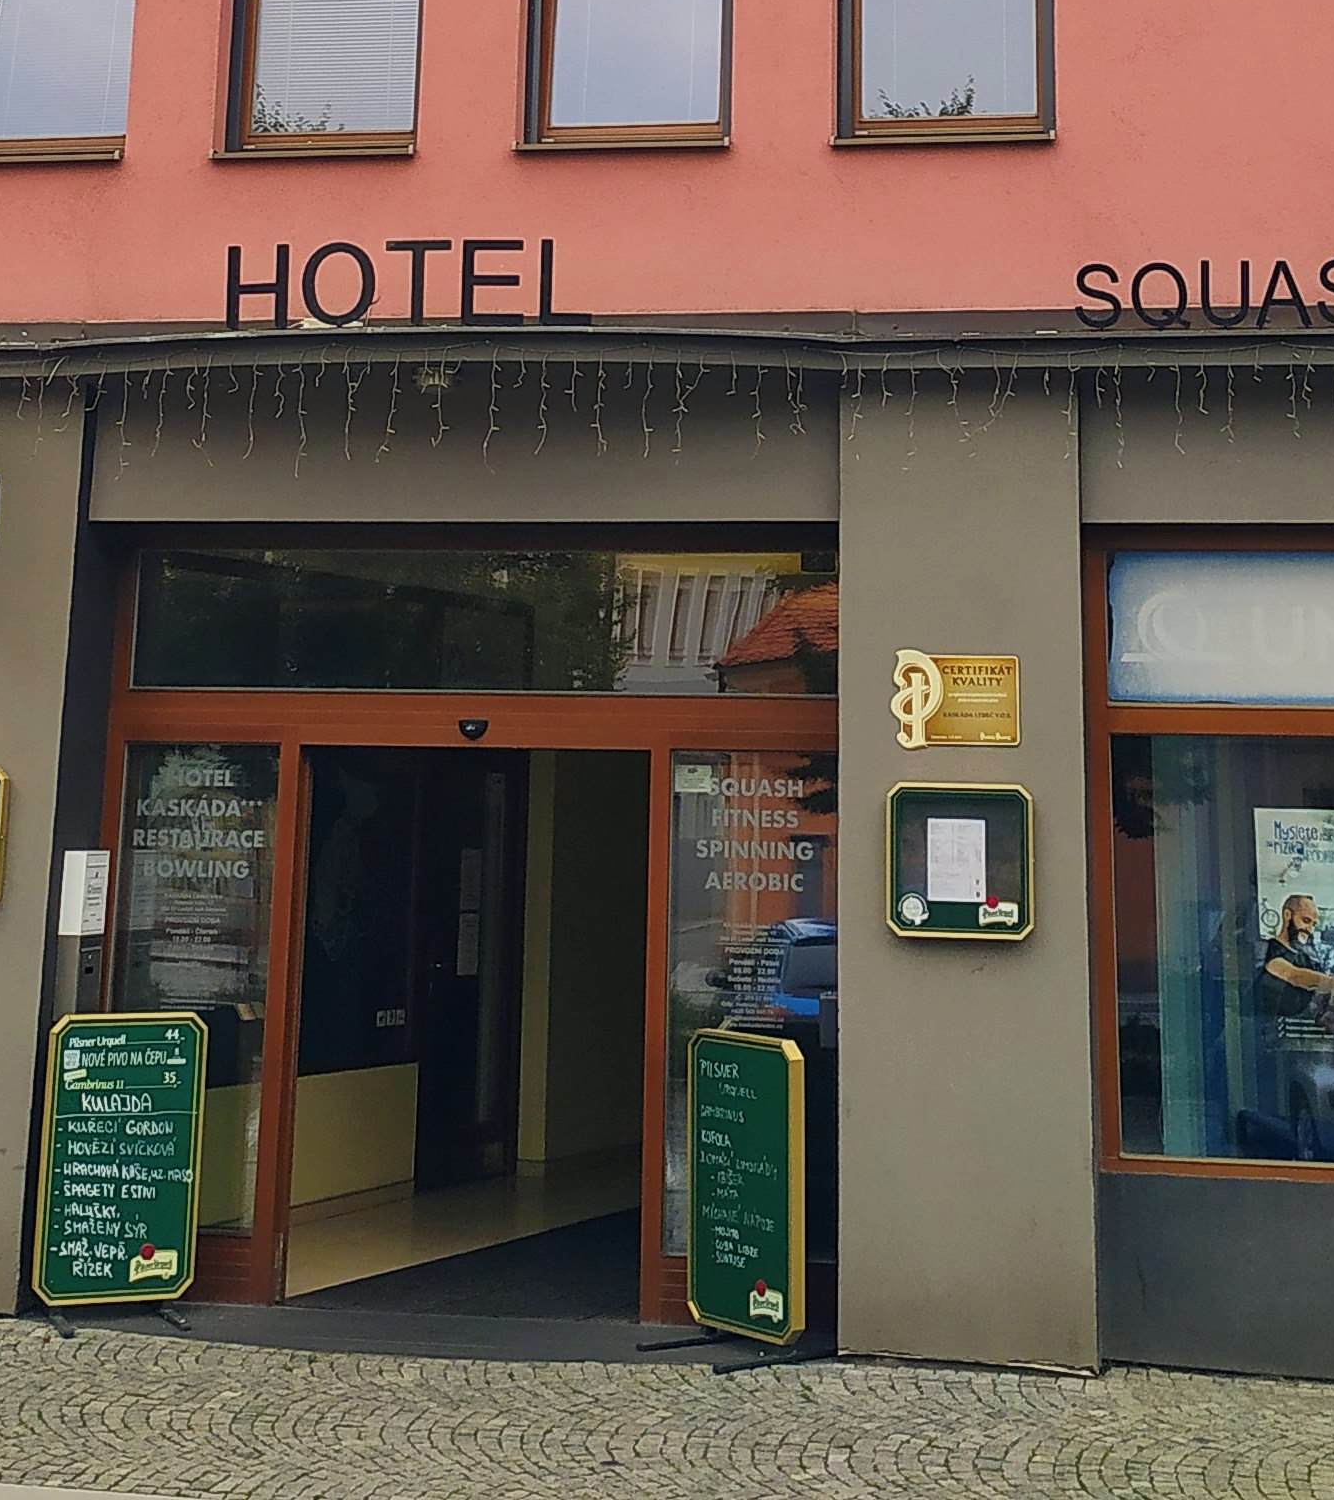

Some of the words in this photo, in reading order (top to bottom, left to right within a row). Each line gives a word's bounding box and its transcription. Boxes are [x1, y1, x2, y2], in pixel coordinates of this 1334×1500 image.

[225, 238, 593, 330] HOTEL
[941, 664, 1013, 676] CERTIFIKÁT
[952, 677, 1003, 686] KVALITY
[707, 778, 804, 798] SQUASH
[136, 794, 242, 817] KASKÁDA
[711, 809, 799, 828] FITNESS
[132, 829, 265, 848] RESTAURACE
[696, 840, 814, 861] SPINNING
[144, 860, 250, 878] BOWLING
[704, 872, 804, 892] AEROBIC
[69, 1037, 96, 1048] Pilsner
[97, 1034, 127, 1048] Urquell
[81, 1049, 106, 1067] NOVÉ
[107, 1051, 128, 1067] PIVO
[130, 1051, 143, 1065] NA
[145, 1048, 167, 1065] ČEPU
[65, 1079, 115, 1090] Gambrinus
[81, 1092, 152, 1112] KULAJDA
[67, 1117, 121, 1134] KUŘECÍ
[125, 1119, 174, 1136] GORDON
[67, 1138, 116, 1156] HOVĚZÍ
[63, 1159, 119, 1178] HRACHOVÁ
[63, 1180, 116, 1198] ŠPAGETY
[72, 1257, 113, 1278] ŘÍZEK
